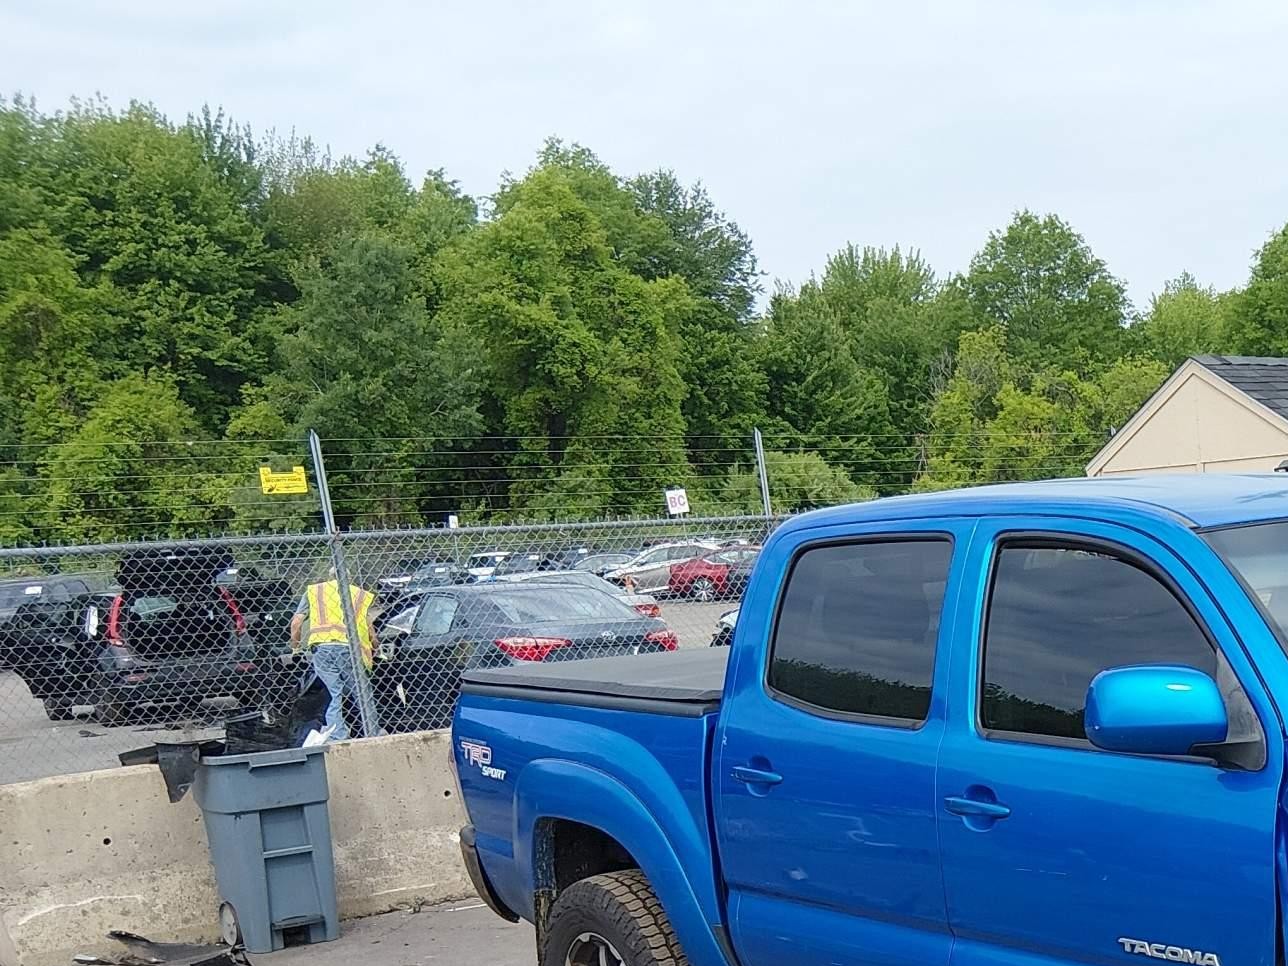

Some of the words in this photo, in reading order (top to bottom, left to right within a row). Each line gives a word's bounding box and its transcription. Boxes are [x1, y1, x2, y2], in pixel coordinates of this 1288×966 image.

[668, 494, 686, 509] BC
[460, 741, 492, 768] TRD
[481, 765, 507, 781] SPORT
